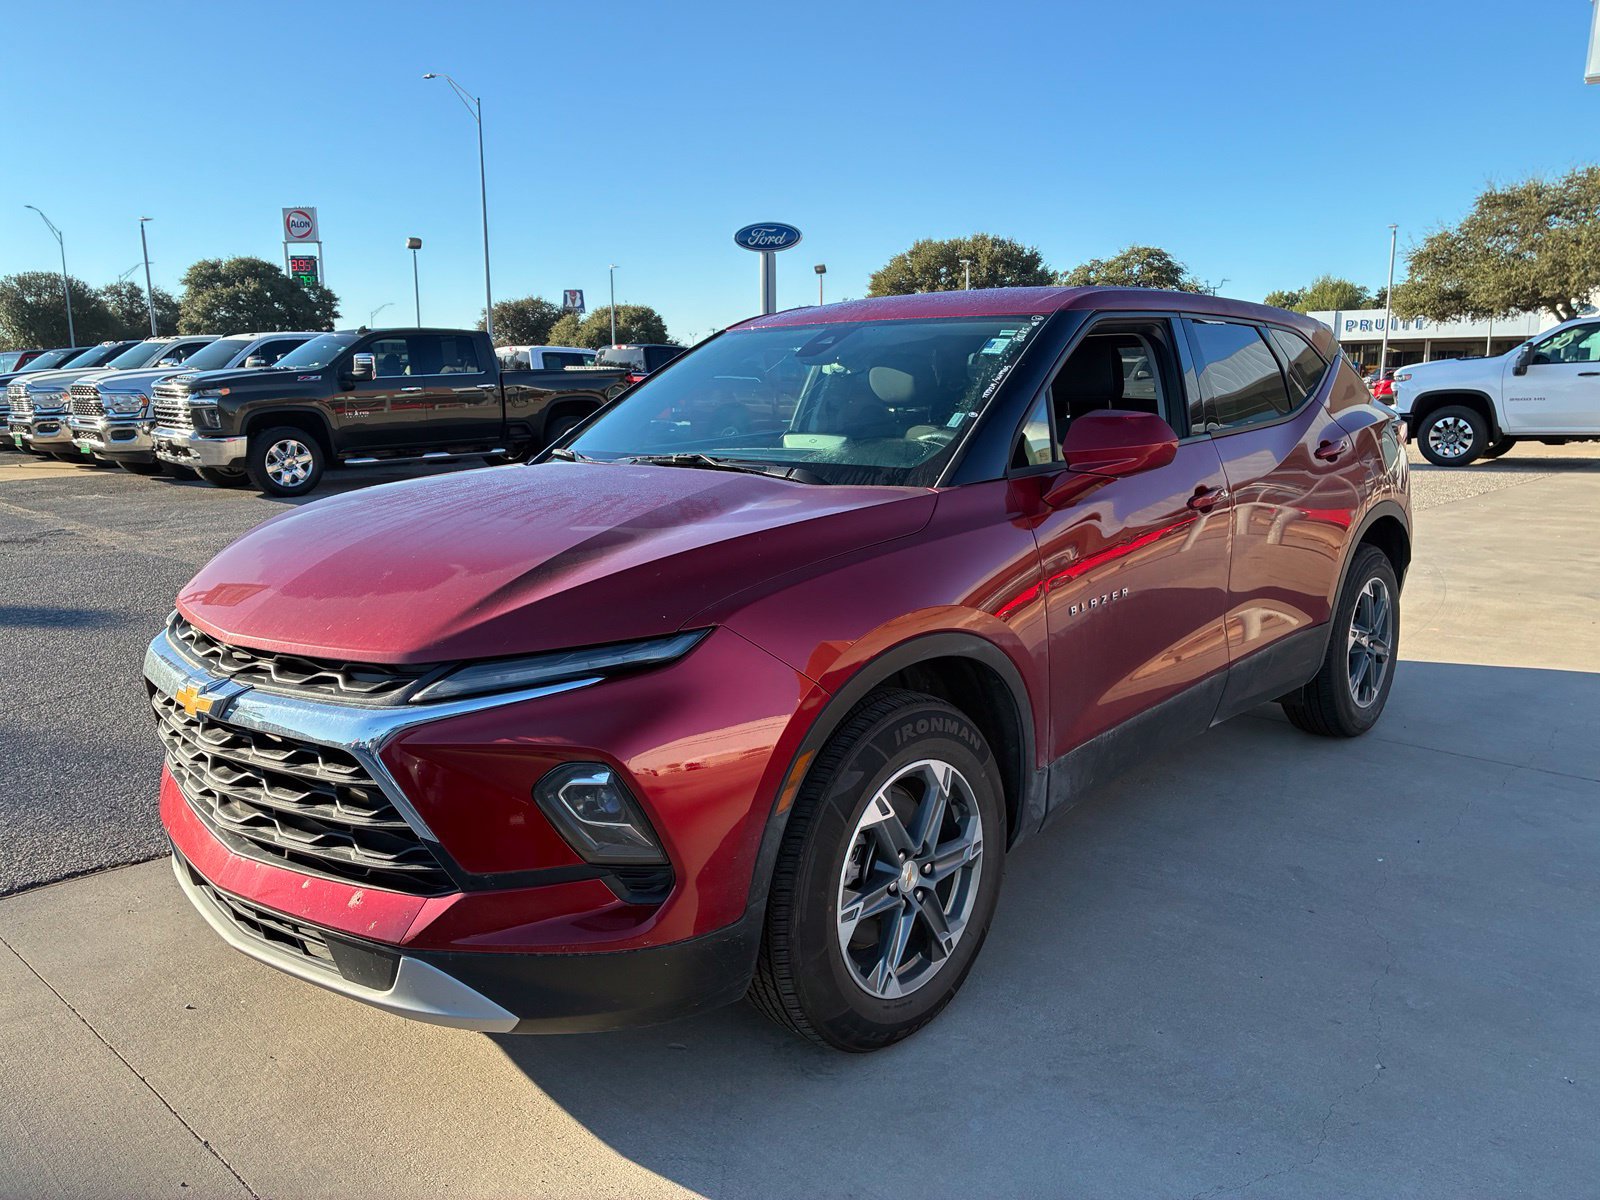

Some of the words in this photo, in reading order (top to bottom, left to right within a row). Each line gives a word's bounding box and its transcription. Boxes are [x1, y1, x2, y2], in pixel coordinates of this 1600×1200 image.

[290, 219, 310, 228] ALON
[747, 228, 787, 246] Ford
[1068, 587, 1129, 617] BLAZER
[894, 717, 981, 751] IRONMAN
